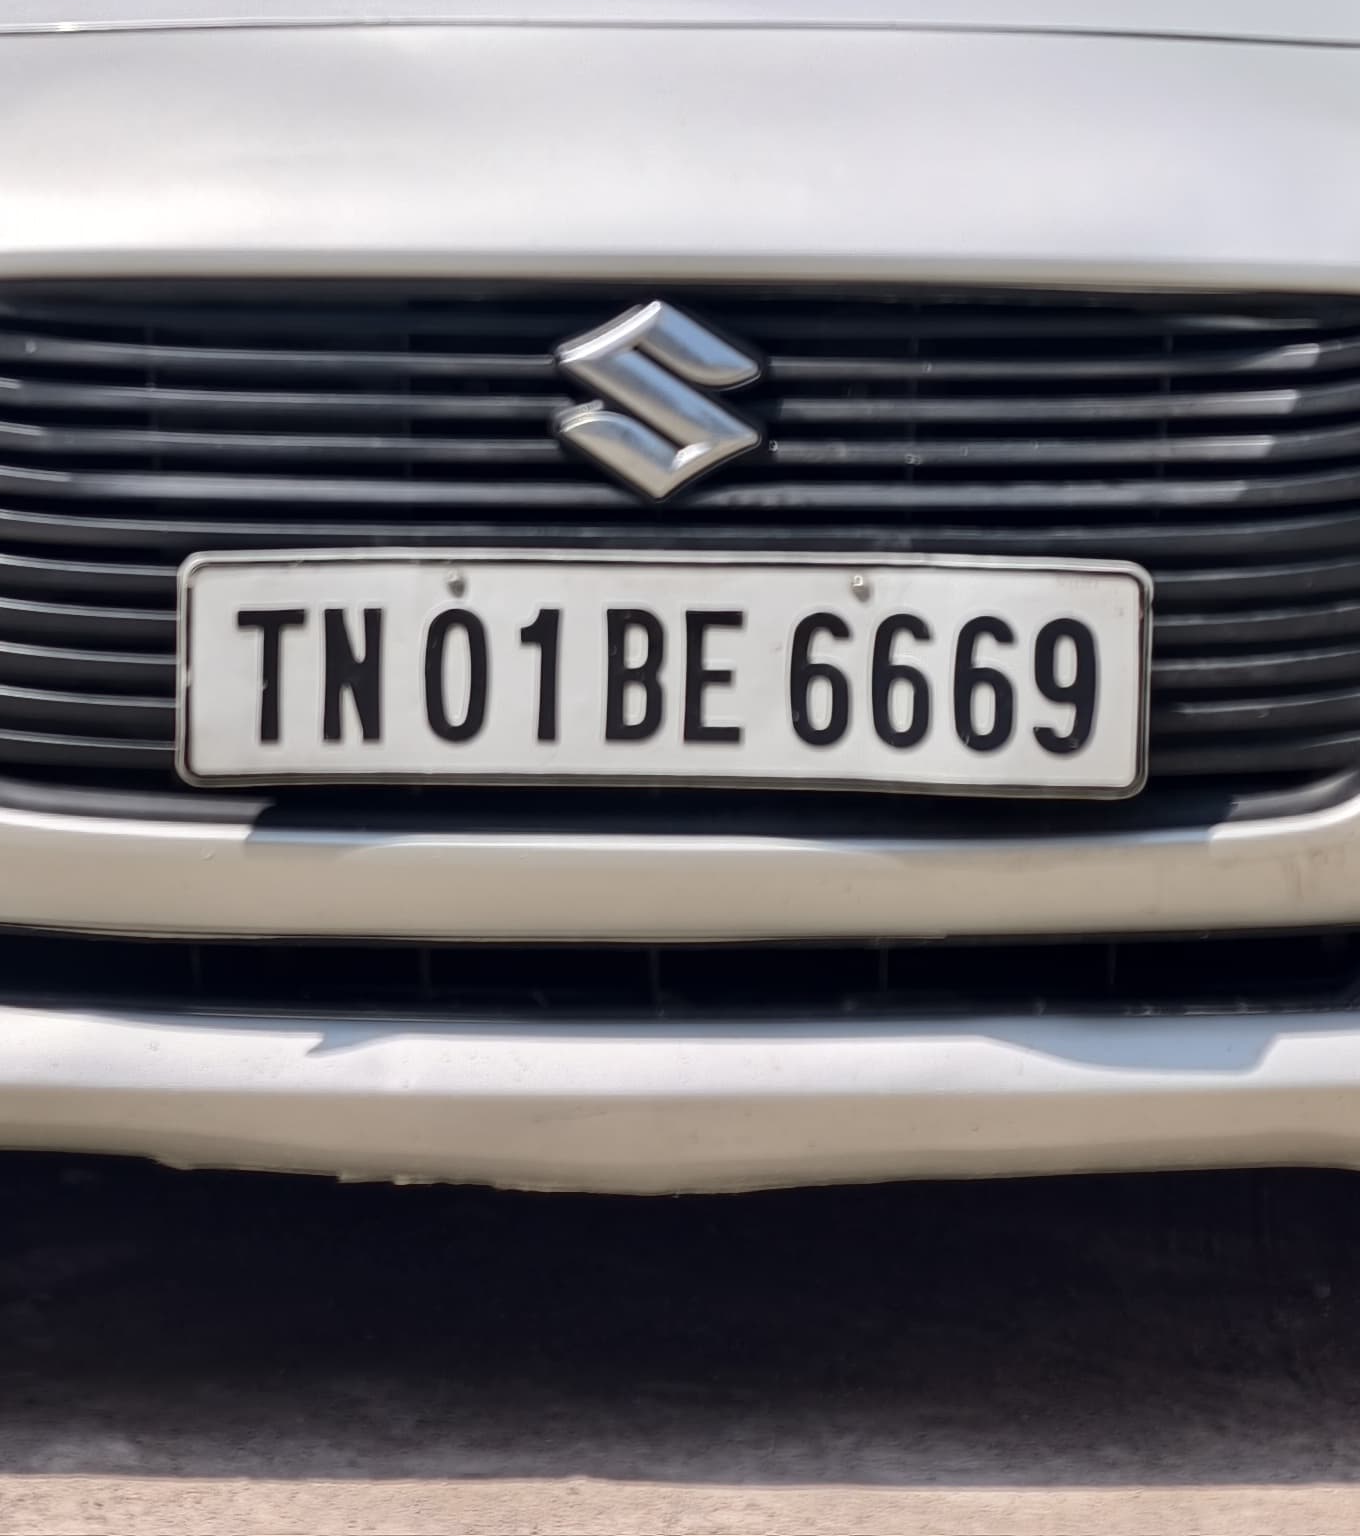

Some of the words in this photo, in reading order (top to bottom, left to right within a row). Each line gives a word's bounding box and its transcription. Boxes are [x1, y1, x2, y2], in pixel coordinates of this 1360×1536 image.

[237, 608, 382, 745] TN
[424, 608, 561, 744] 01
[605, 608, 744, 744] BE
[789, 610, 1098, 757] 6669
